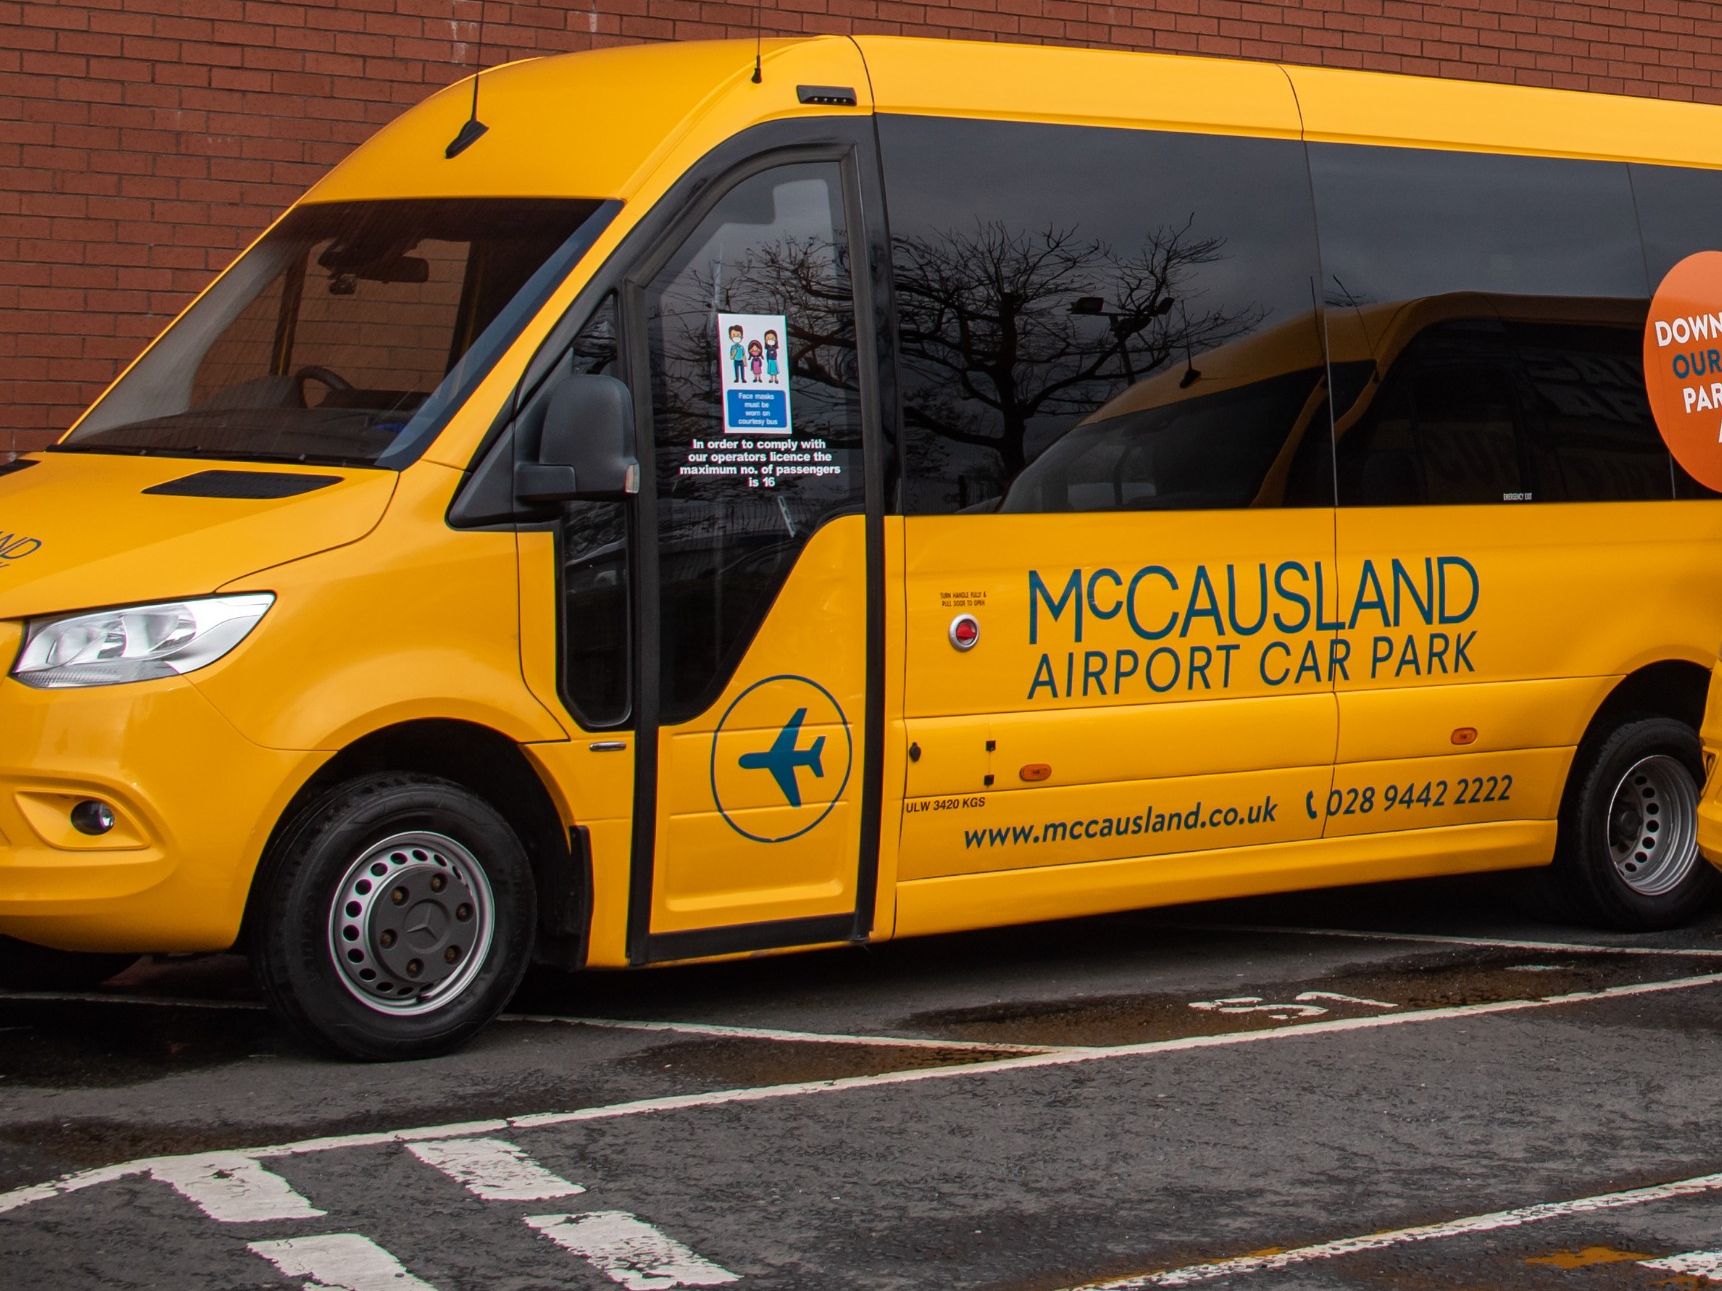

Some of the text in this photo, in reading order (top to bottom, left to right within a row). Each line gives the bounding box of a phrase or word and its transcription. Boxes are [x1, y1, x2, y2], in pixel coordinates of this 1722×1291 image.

[1672, 347, 1722, 379] OUR
[738, 392, 753, 400] Face
[738, 418, 765, 426] courtesy
[693, 439, 826, 451] In order to comply with
[688, 451, 832, 465] our operators licence the
[679, 464, 841, 477] maximum no. of passengers
[748, 477, 775, 487] is 16
[1028, 555, 1480, 645] McCAUSLAND
[1026, 630, 1479, 700] AIRPORT CAR PARK
[906, 796, 986, 814] ULW 3420 KGS
[963, 774, 1514, 850] www.mccausland.co.uk 028 9442 2222
